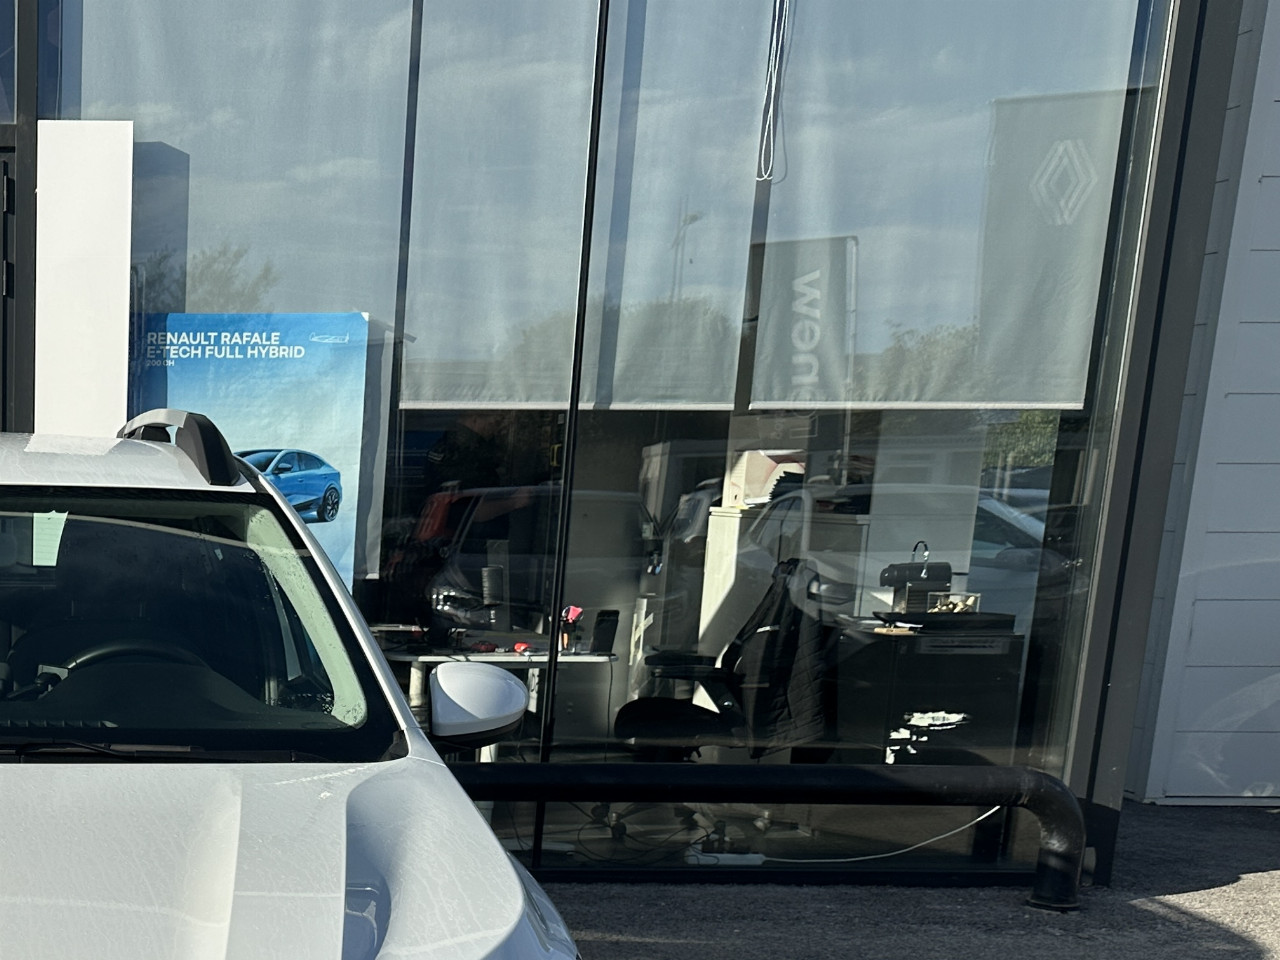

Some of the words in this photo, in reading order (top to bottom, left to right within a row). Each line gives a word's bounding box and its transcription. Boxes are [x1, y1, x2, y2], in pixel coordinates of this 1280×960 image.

[147, 332, 218, 345] RENAULT
[221, 332, 280, 345] RAFALE
[146, 346, 201, 358] E-TECH
[205, 346, 244, 359] FULL
[247, 346, 305, 359] HYBRID
